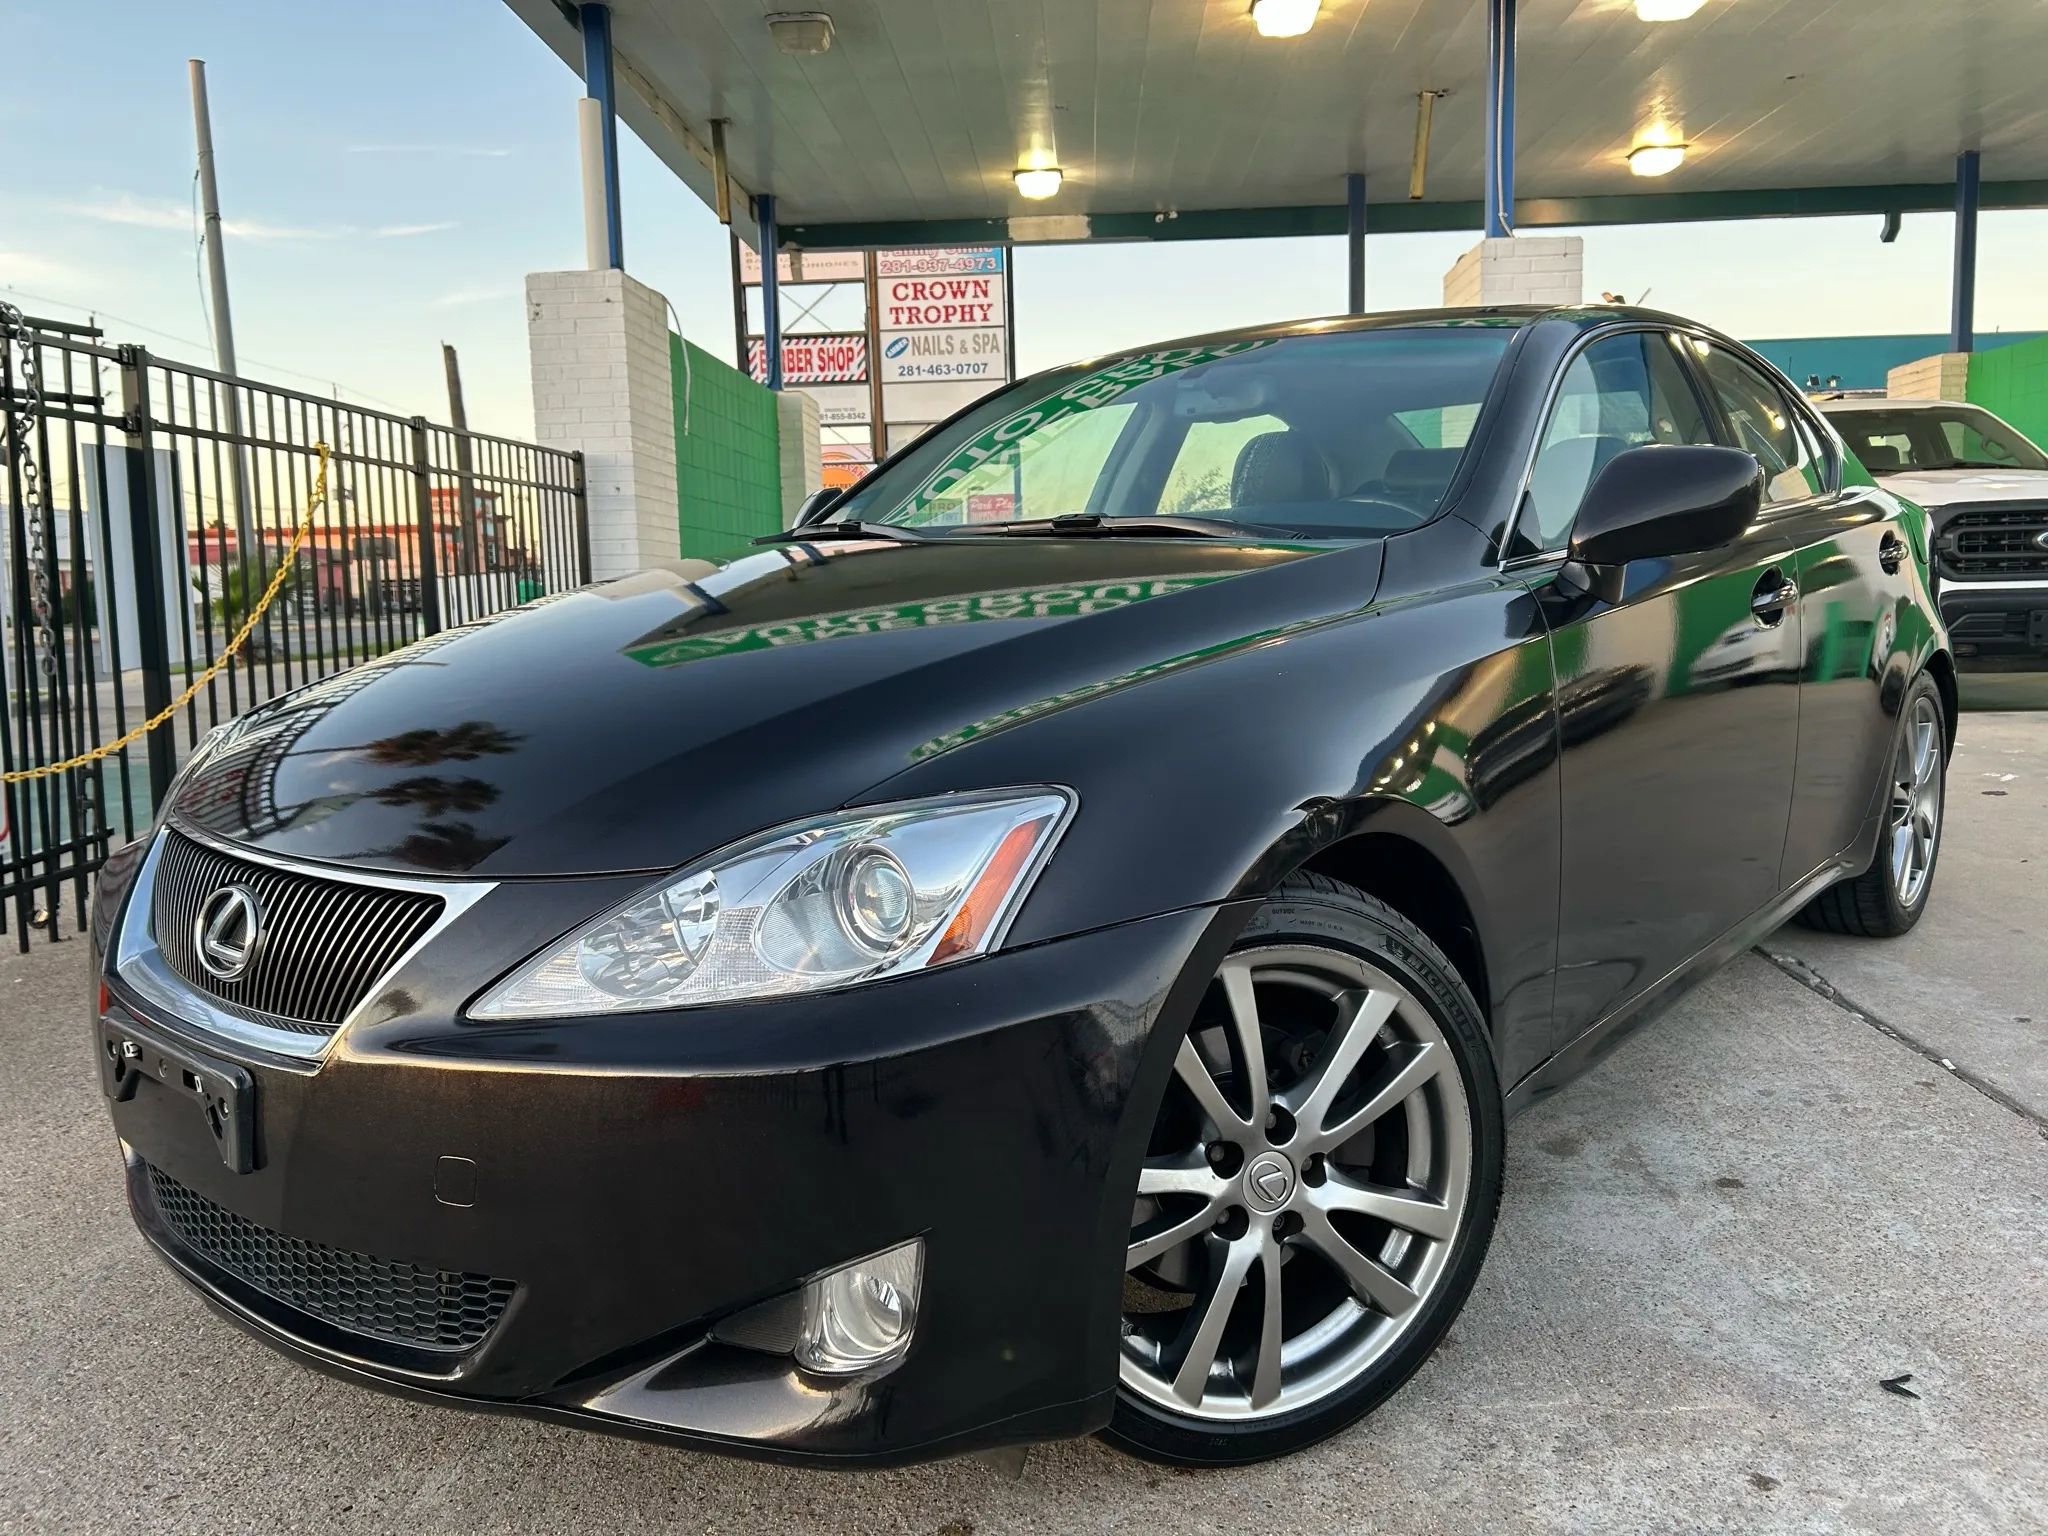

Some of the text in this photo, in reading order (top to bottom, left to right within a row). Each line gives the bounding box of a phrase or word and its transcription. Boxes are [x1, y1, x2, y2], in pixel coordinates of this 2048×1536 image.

[880, 257, 997, 274] 281-937-4973
[892, 280, 990, 301] CROWN
[889, 304, 993, 325] TROPHY
[911, 333, 1000, 356] NAILS & SPA
[760, 346, 854, 374] BBER SHOP
[898, 363, 988, 377] 281-463-0707
[819, 412, 866, 421] 81-855-8342
